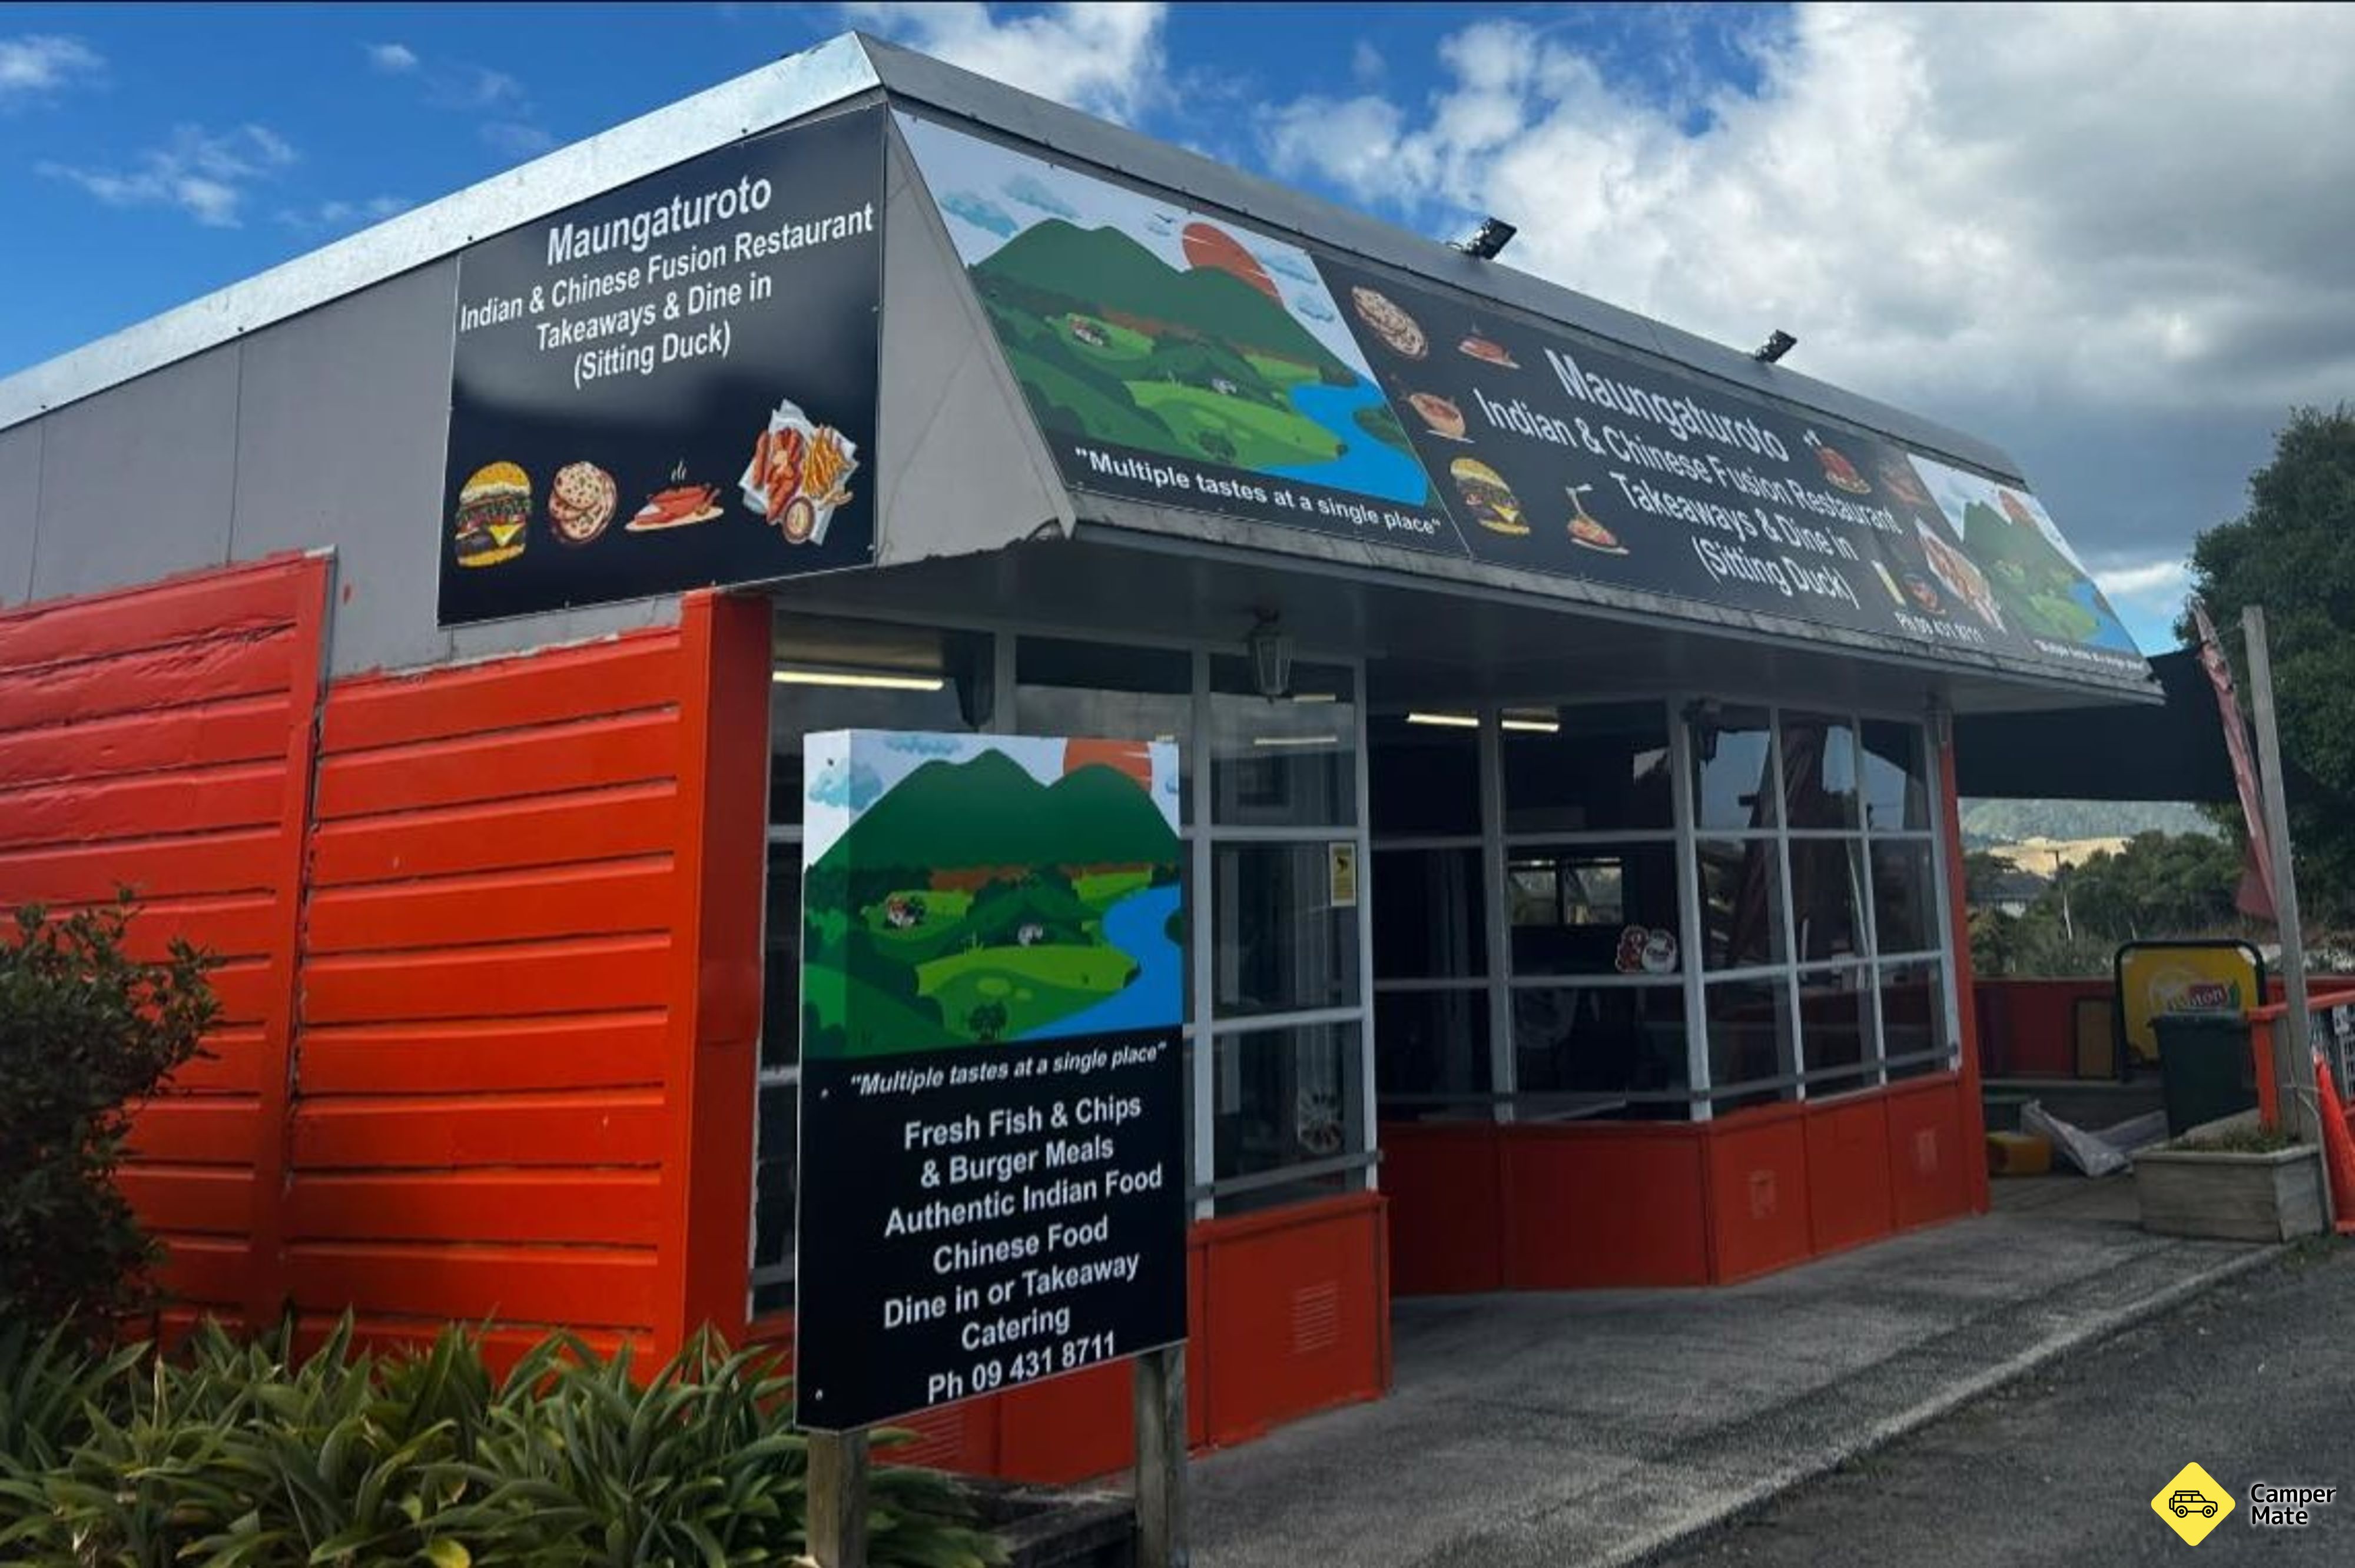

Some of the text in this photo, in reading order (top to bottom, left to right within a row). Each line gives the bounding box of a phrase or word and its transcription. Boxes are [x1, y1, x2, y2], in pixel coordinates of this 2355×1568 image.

[547, 176, 772, 266] Maungaturoto
[460, 202, 874, 332] Indian & Chinese Fusion Restaurant
[536, 272, 772, 351] Takeaways & Dine in
[573, 320, 731, 390] (Sitting Duck)
[1544, 347, 1790, 462] Maungaturoto
[1473, 388, 1903, 535] Indian & Chinese Fusion Restaurant
[1196, 473, 1267, 503] tastes
[1275, 489, 1296, 507] at
[1299, 496, 1313, 512] a
[1318, 497, 1379, 527] single
[1609, 472, 1858, 561] Takeaways & Dine in
[1691, 537, 1860, 610] (Sitting Duck)
[949, 1058, 1009, 1085] tastes
[1014, 1058, 1033, 1078] at
[1036, 1059, 1048, 1075] a
[1053, 1046, 1107, 1072] single
[904, 1095, 1142, 1150] Fresh Fish & Chips
[921, 1134, 1114, 1188] & Burger Meals
[884, 1162, 1162, 1237] Authentic Indian Food
[933, 1215, 1108, 1274] Chinese Food
[884, 1253, 1140, 1328] Dine in or Takeaway
[961, 1306, 1070, 1351] Catering
[927, 1330, 1115, 1404] Ph 09 431 8711
